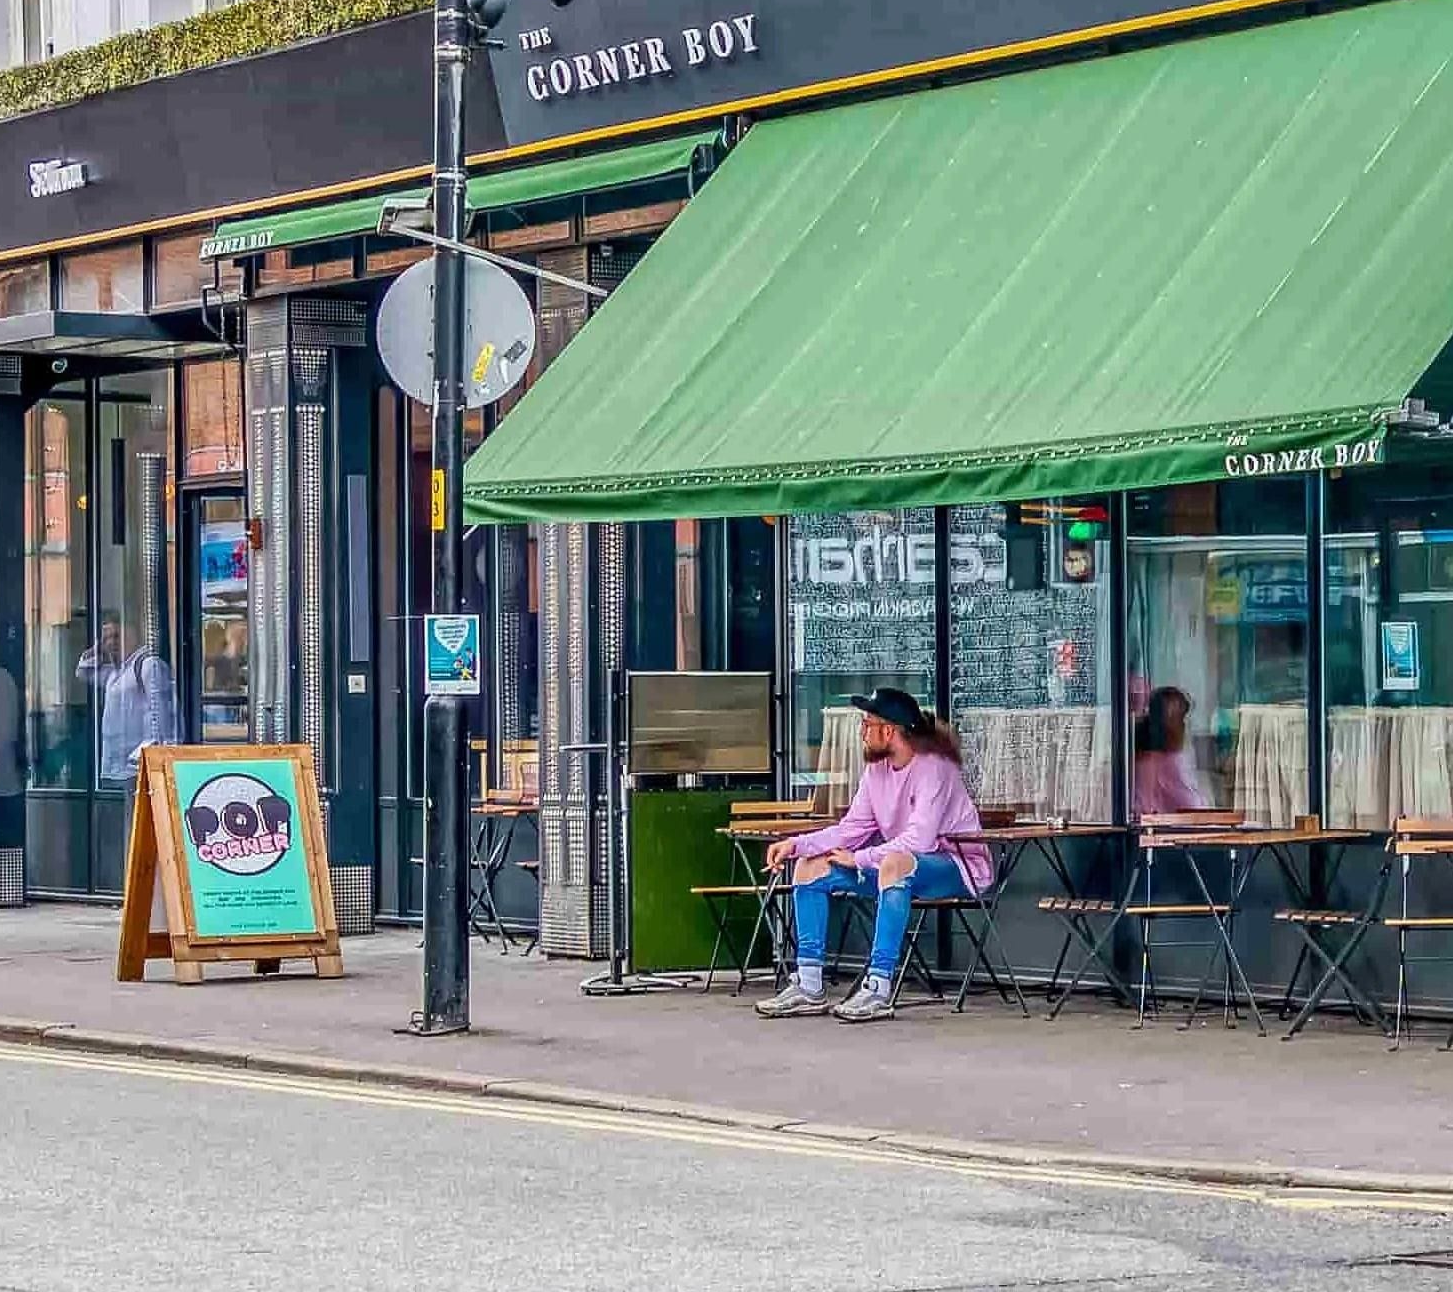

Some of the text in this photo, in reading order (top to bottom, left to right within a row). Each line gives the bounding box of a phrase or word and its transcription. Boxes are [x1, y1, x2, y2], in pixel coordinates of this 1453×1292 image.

[518, 27, 552, 50] THE
[526, 14, 759, 101] CORNER BOY
[1226, 435, 1248, 446] THE
[1225, 439, 1379, 477] CORNER BOY
[184, 795, 292, 846] POP
[198, 832, 291, 862] CORNER
